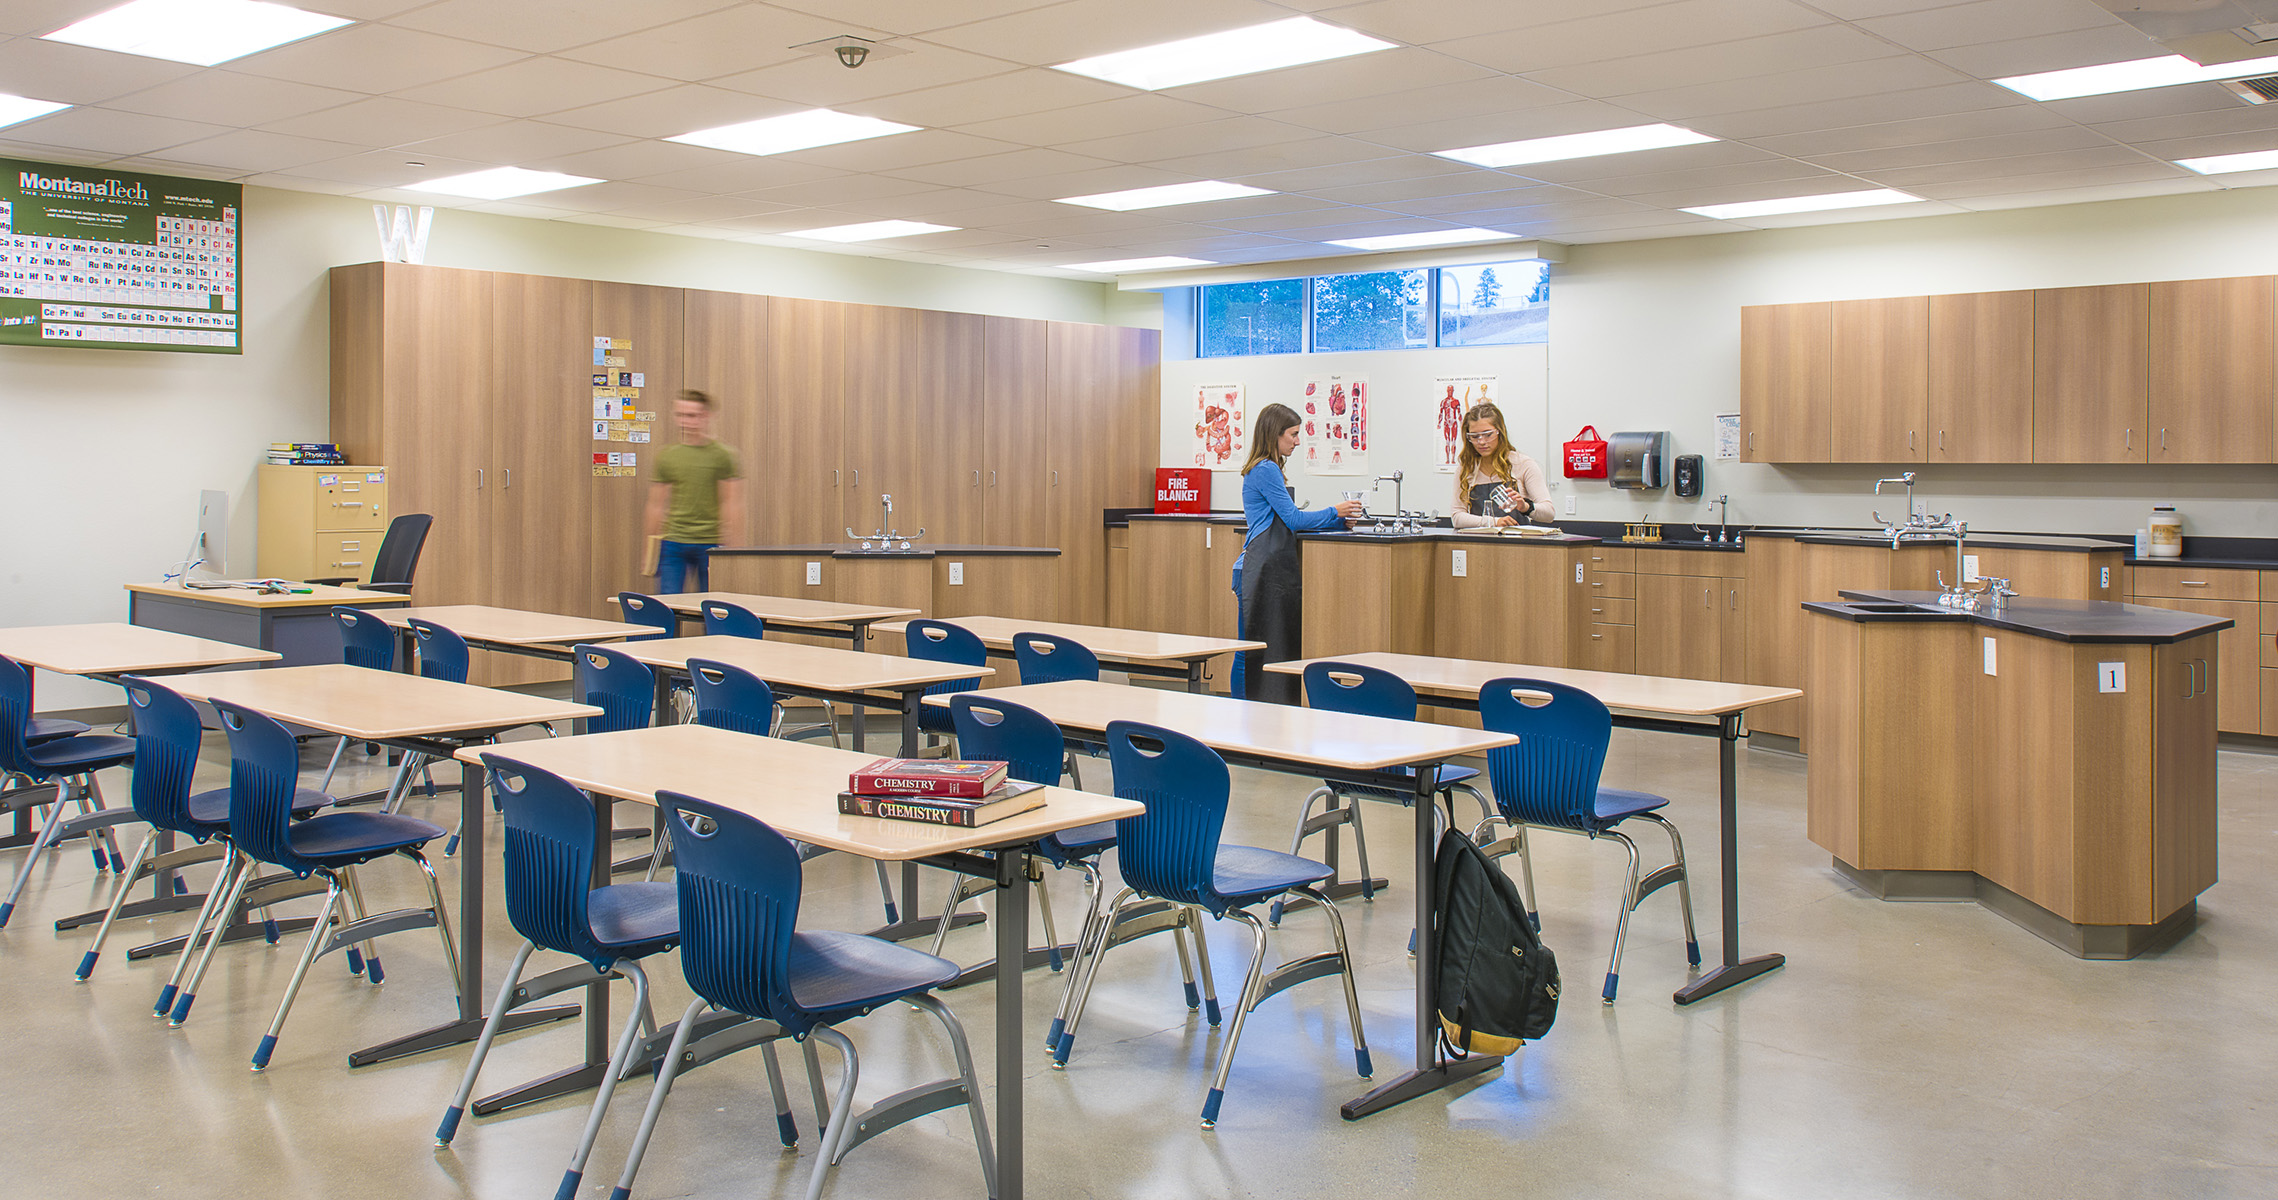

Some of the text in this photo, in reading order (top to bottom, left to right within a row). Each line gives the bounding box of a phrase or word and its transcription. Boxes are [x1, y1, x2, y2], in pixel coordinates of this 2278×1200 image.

[19, 171, 149, 200] MontanaTech
[40, 192, 92, 201] UNIVERSITY
[164, 195, 214, 204] www.mtech.edu
[373, 205, 434, 264] W
[1168, 478, 1188, 489] FIRE
[1158, 490, 1198, 501] BLANKET
[2103, 571, 2108, 584] 3
[2109, 670, 2117, 688] 1
[874, 778, 936, 791] CHEMISTRY
[878, 802, 950, 824] CHEMISTRY
